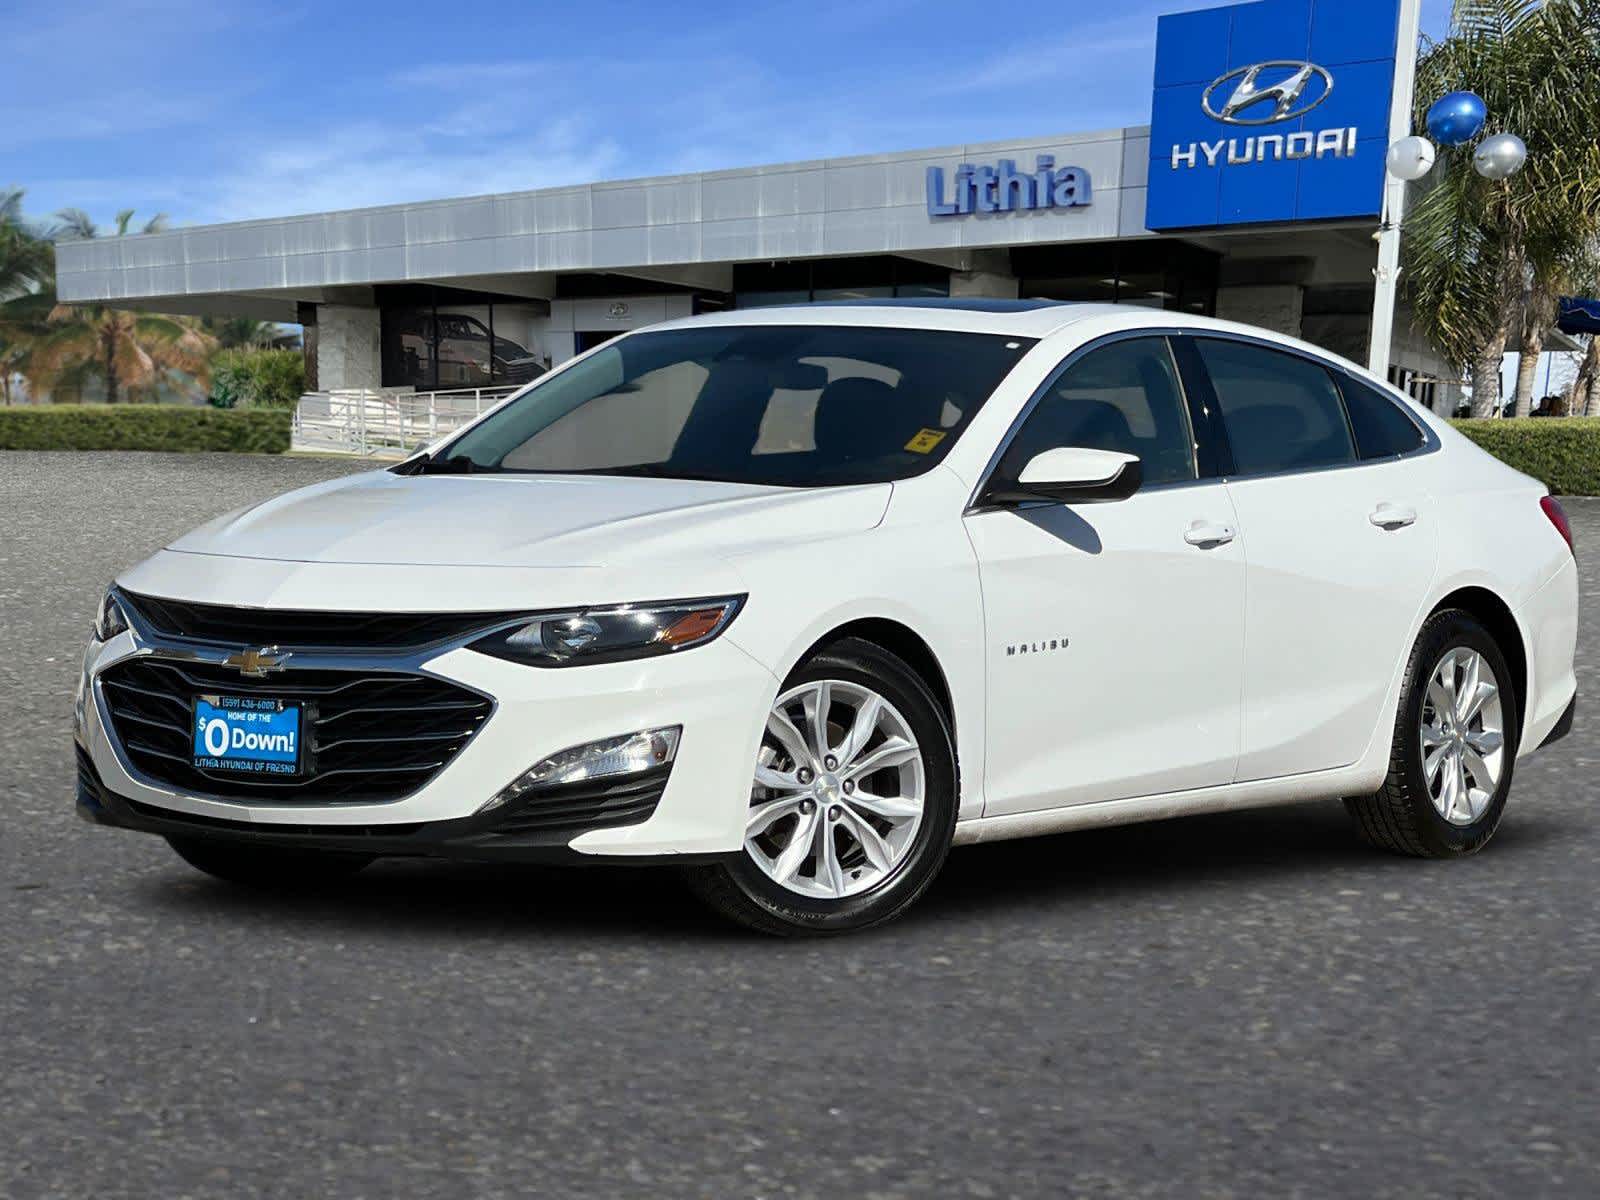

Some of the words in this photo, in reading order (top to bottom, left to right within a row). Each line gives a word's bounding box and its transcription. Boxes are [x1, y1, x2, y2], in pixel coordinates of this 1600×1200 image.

[1170, 127, 1357, 169] HYUNDAI
[926, 154, 1093, 216] Lithia
[1006, 637, 1069, 656] MALIBU
[222, 697, 240, 708] (559)
[241, 699, 275, 710] 436-6000
[227, 711, 246, 721] HOME
[247, 713, 257, 721] OF
[258, 713, 272, 723] THE
[231, 727, 295, 753] Down!
[194, 757, 219, 768] LITHIA
[220, 759, 253, 770] HYUNDAI
[254, 761, 265, 771] OF
[265, 762, 296, 773] FRESNO
